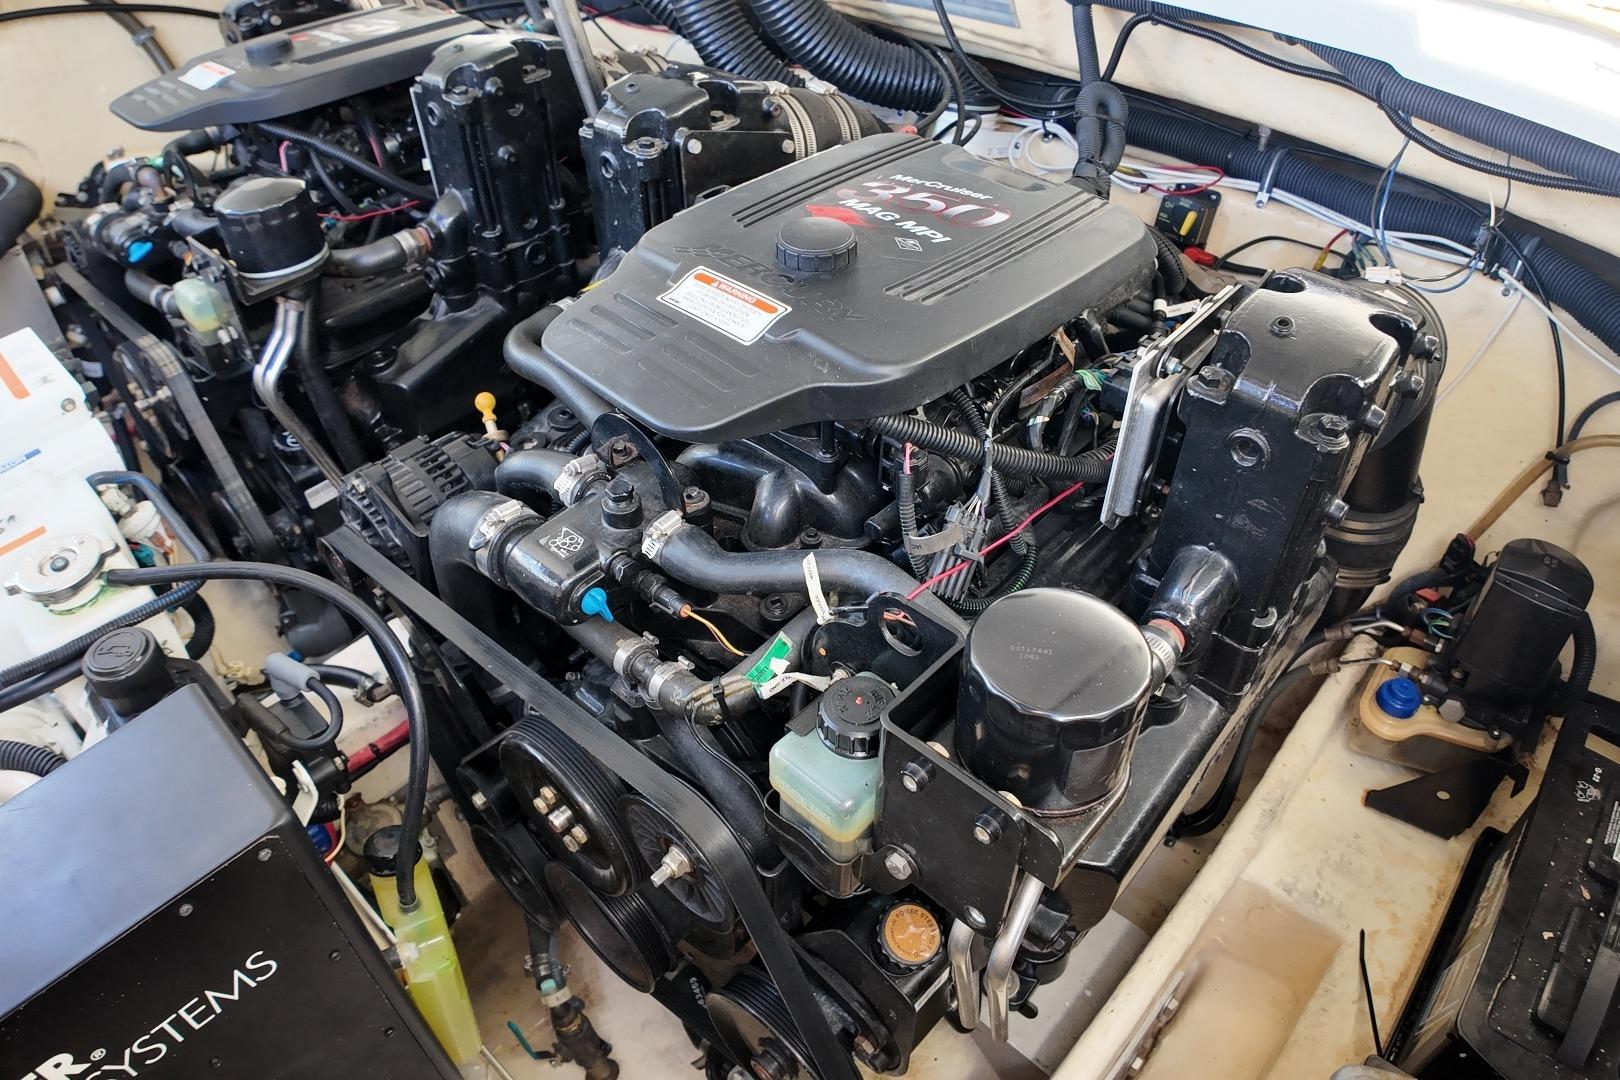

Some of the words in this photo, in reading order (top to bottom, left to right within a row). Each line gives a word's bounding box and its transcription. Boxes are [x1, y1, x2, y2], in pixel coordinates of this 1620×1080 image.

[836, 181, 1012, 228] 350
[889, 174, 994, 200] MerCruiser
[838, 199, 900, 222] MAG
[895, 220, 952, 243] MPI
[715, 281, 758, 304] WARNING
[85, 950, 278, 1080] YSTEMS
